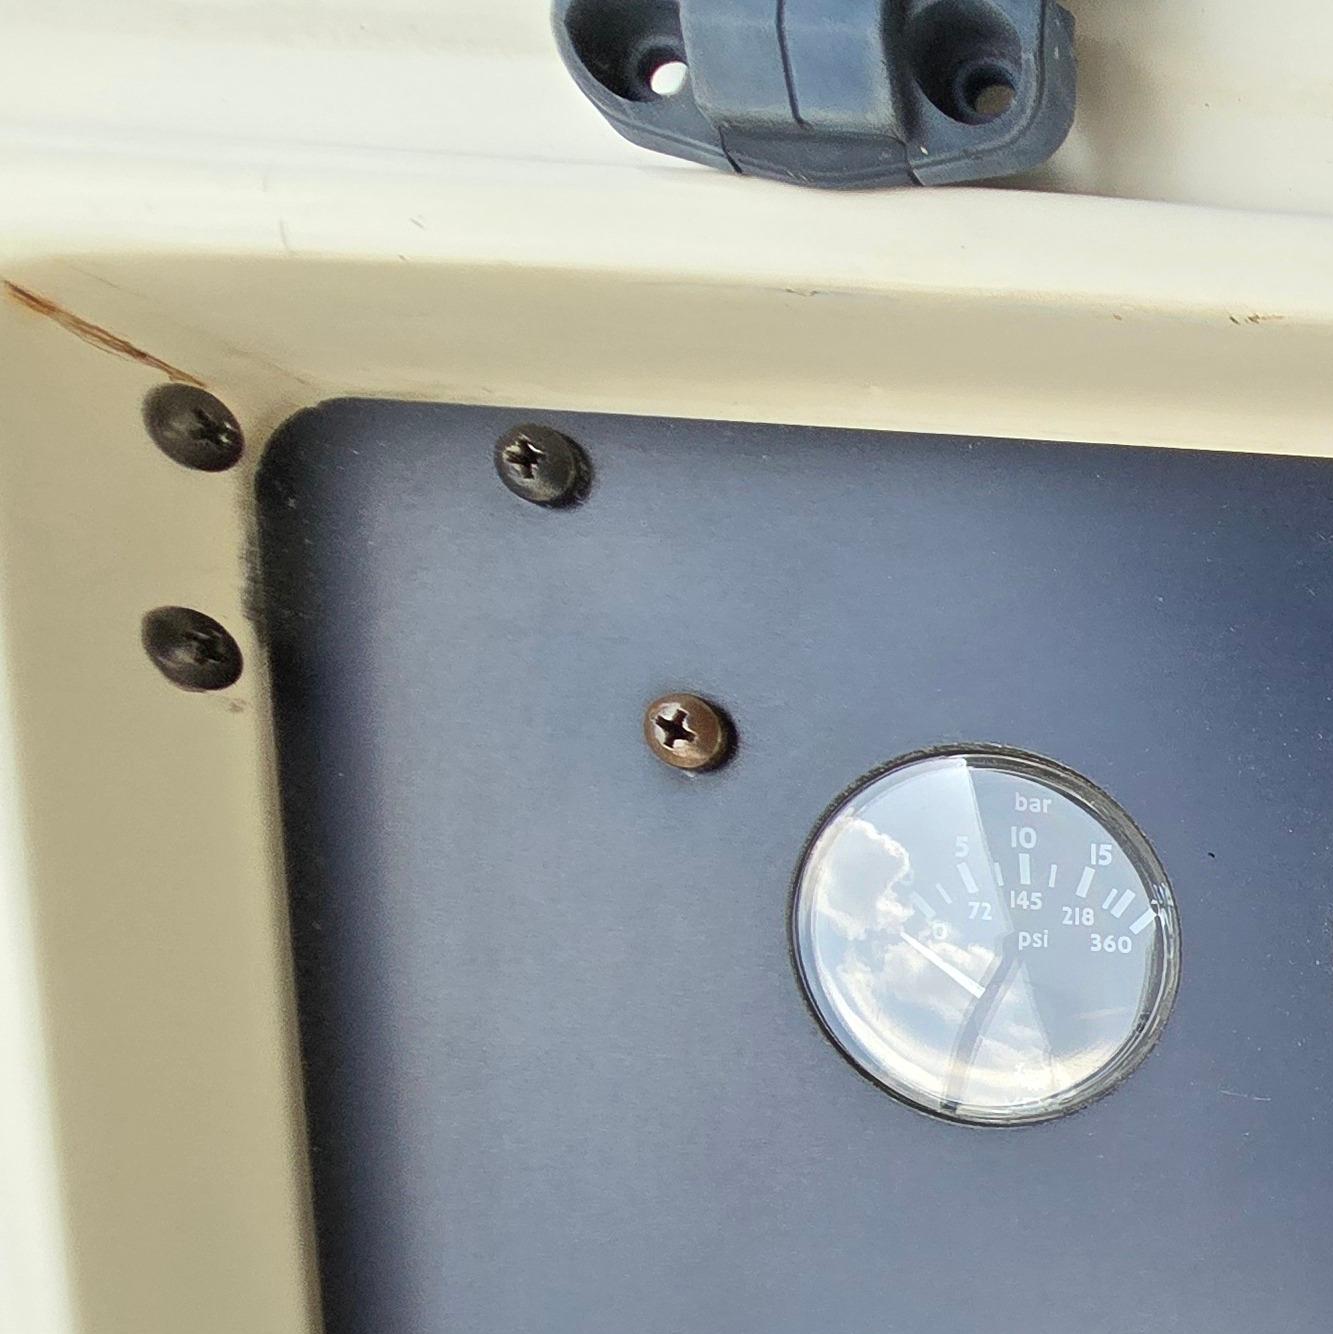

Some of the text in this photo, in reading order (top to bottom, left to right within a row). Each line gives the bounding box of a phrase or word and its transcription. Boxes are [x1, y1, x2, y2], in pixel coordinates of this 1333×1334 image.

[1014, 792, 1051, 814] bar
[954, 835, 970, 858] 5
[1010, 826, 1037, 848] 10
[1090, 844, 1112, 866] 15
[967, 901, 993, 921] 72
[1010, 890, 1042, 911] 145
[1062, 907, 1094, 927] 218
[931, 921, 948, 940] 0
[1018, 930, 1049, 951] psi
[1090, 936, 1132, 954] 360
